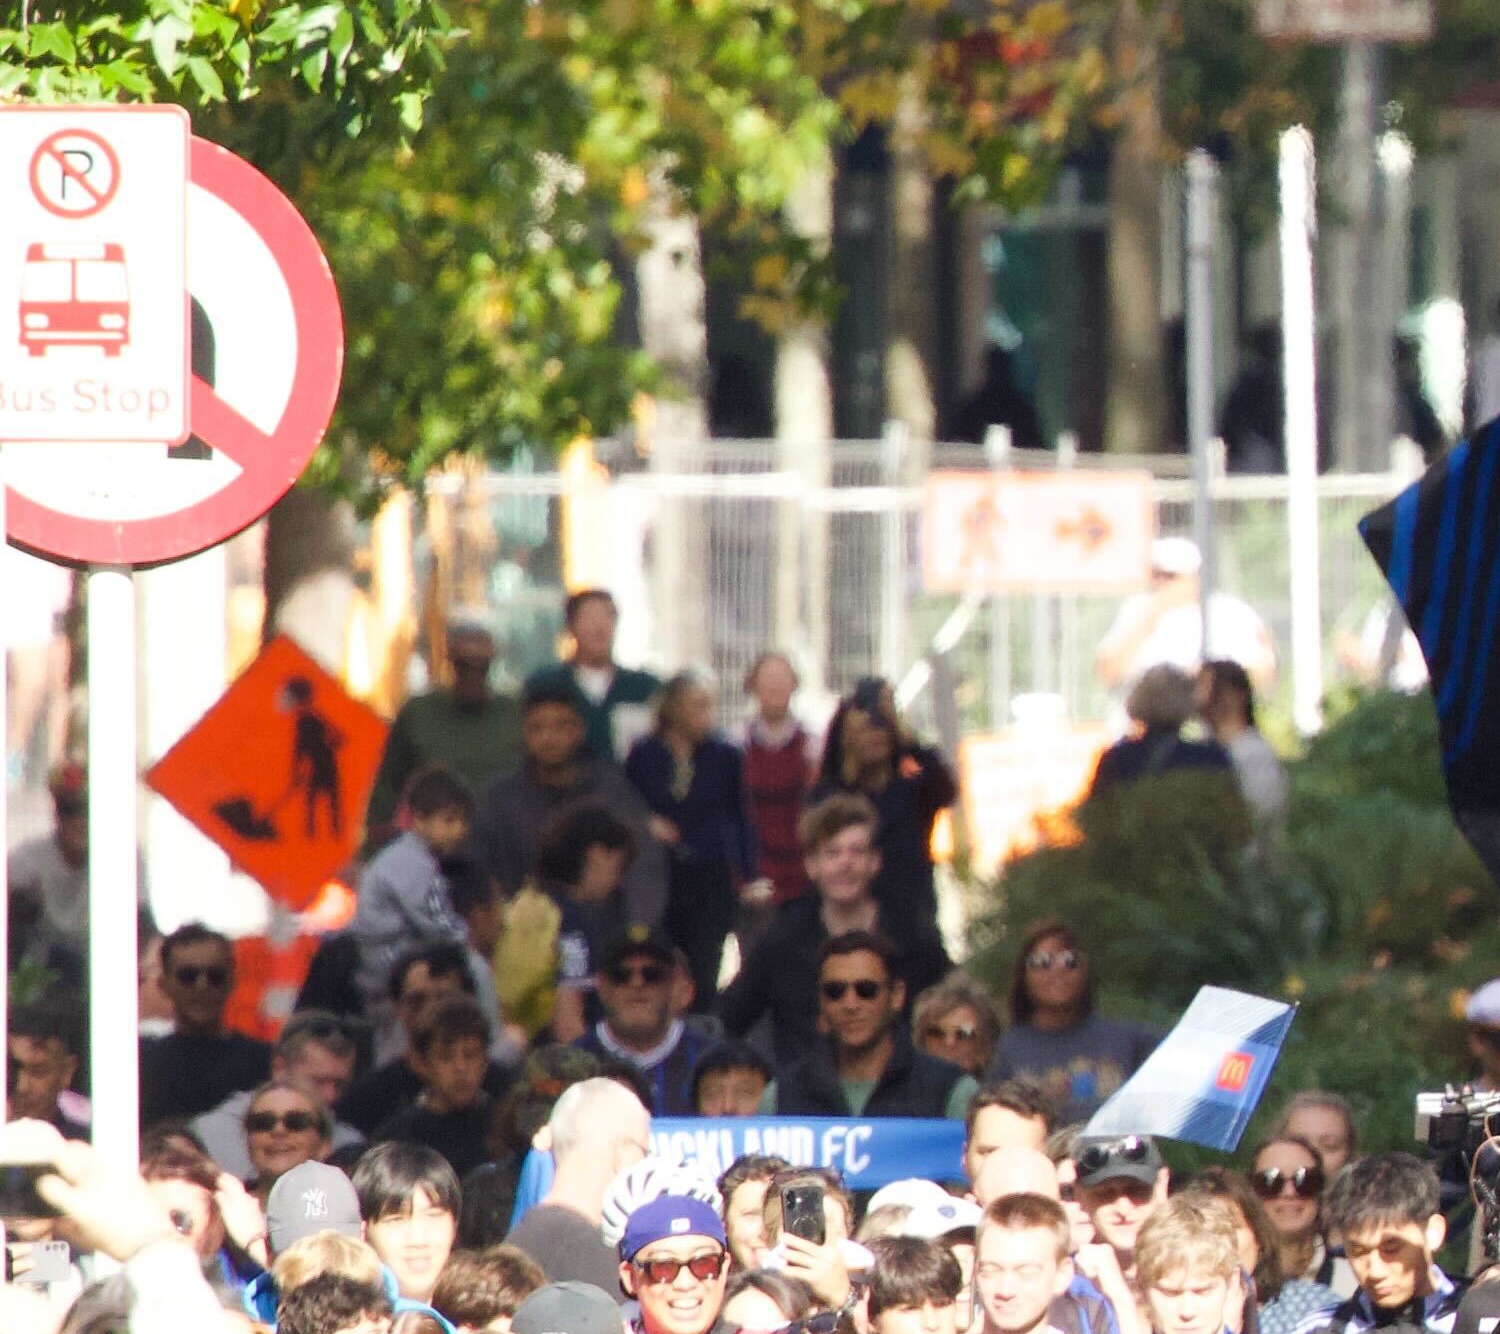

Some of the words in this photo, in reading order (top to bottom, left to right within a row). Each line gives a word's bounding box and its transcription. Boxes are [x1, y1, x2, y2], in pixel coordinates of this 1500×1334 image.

[73, 378, 171, 423] Stop
[648, 1126, 814, 1174] UCKLAND
[822, 1124, 874, 1175] FC
